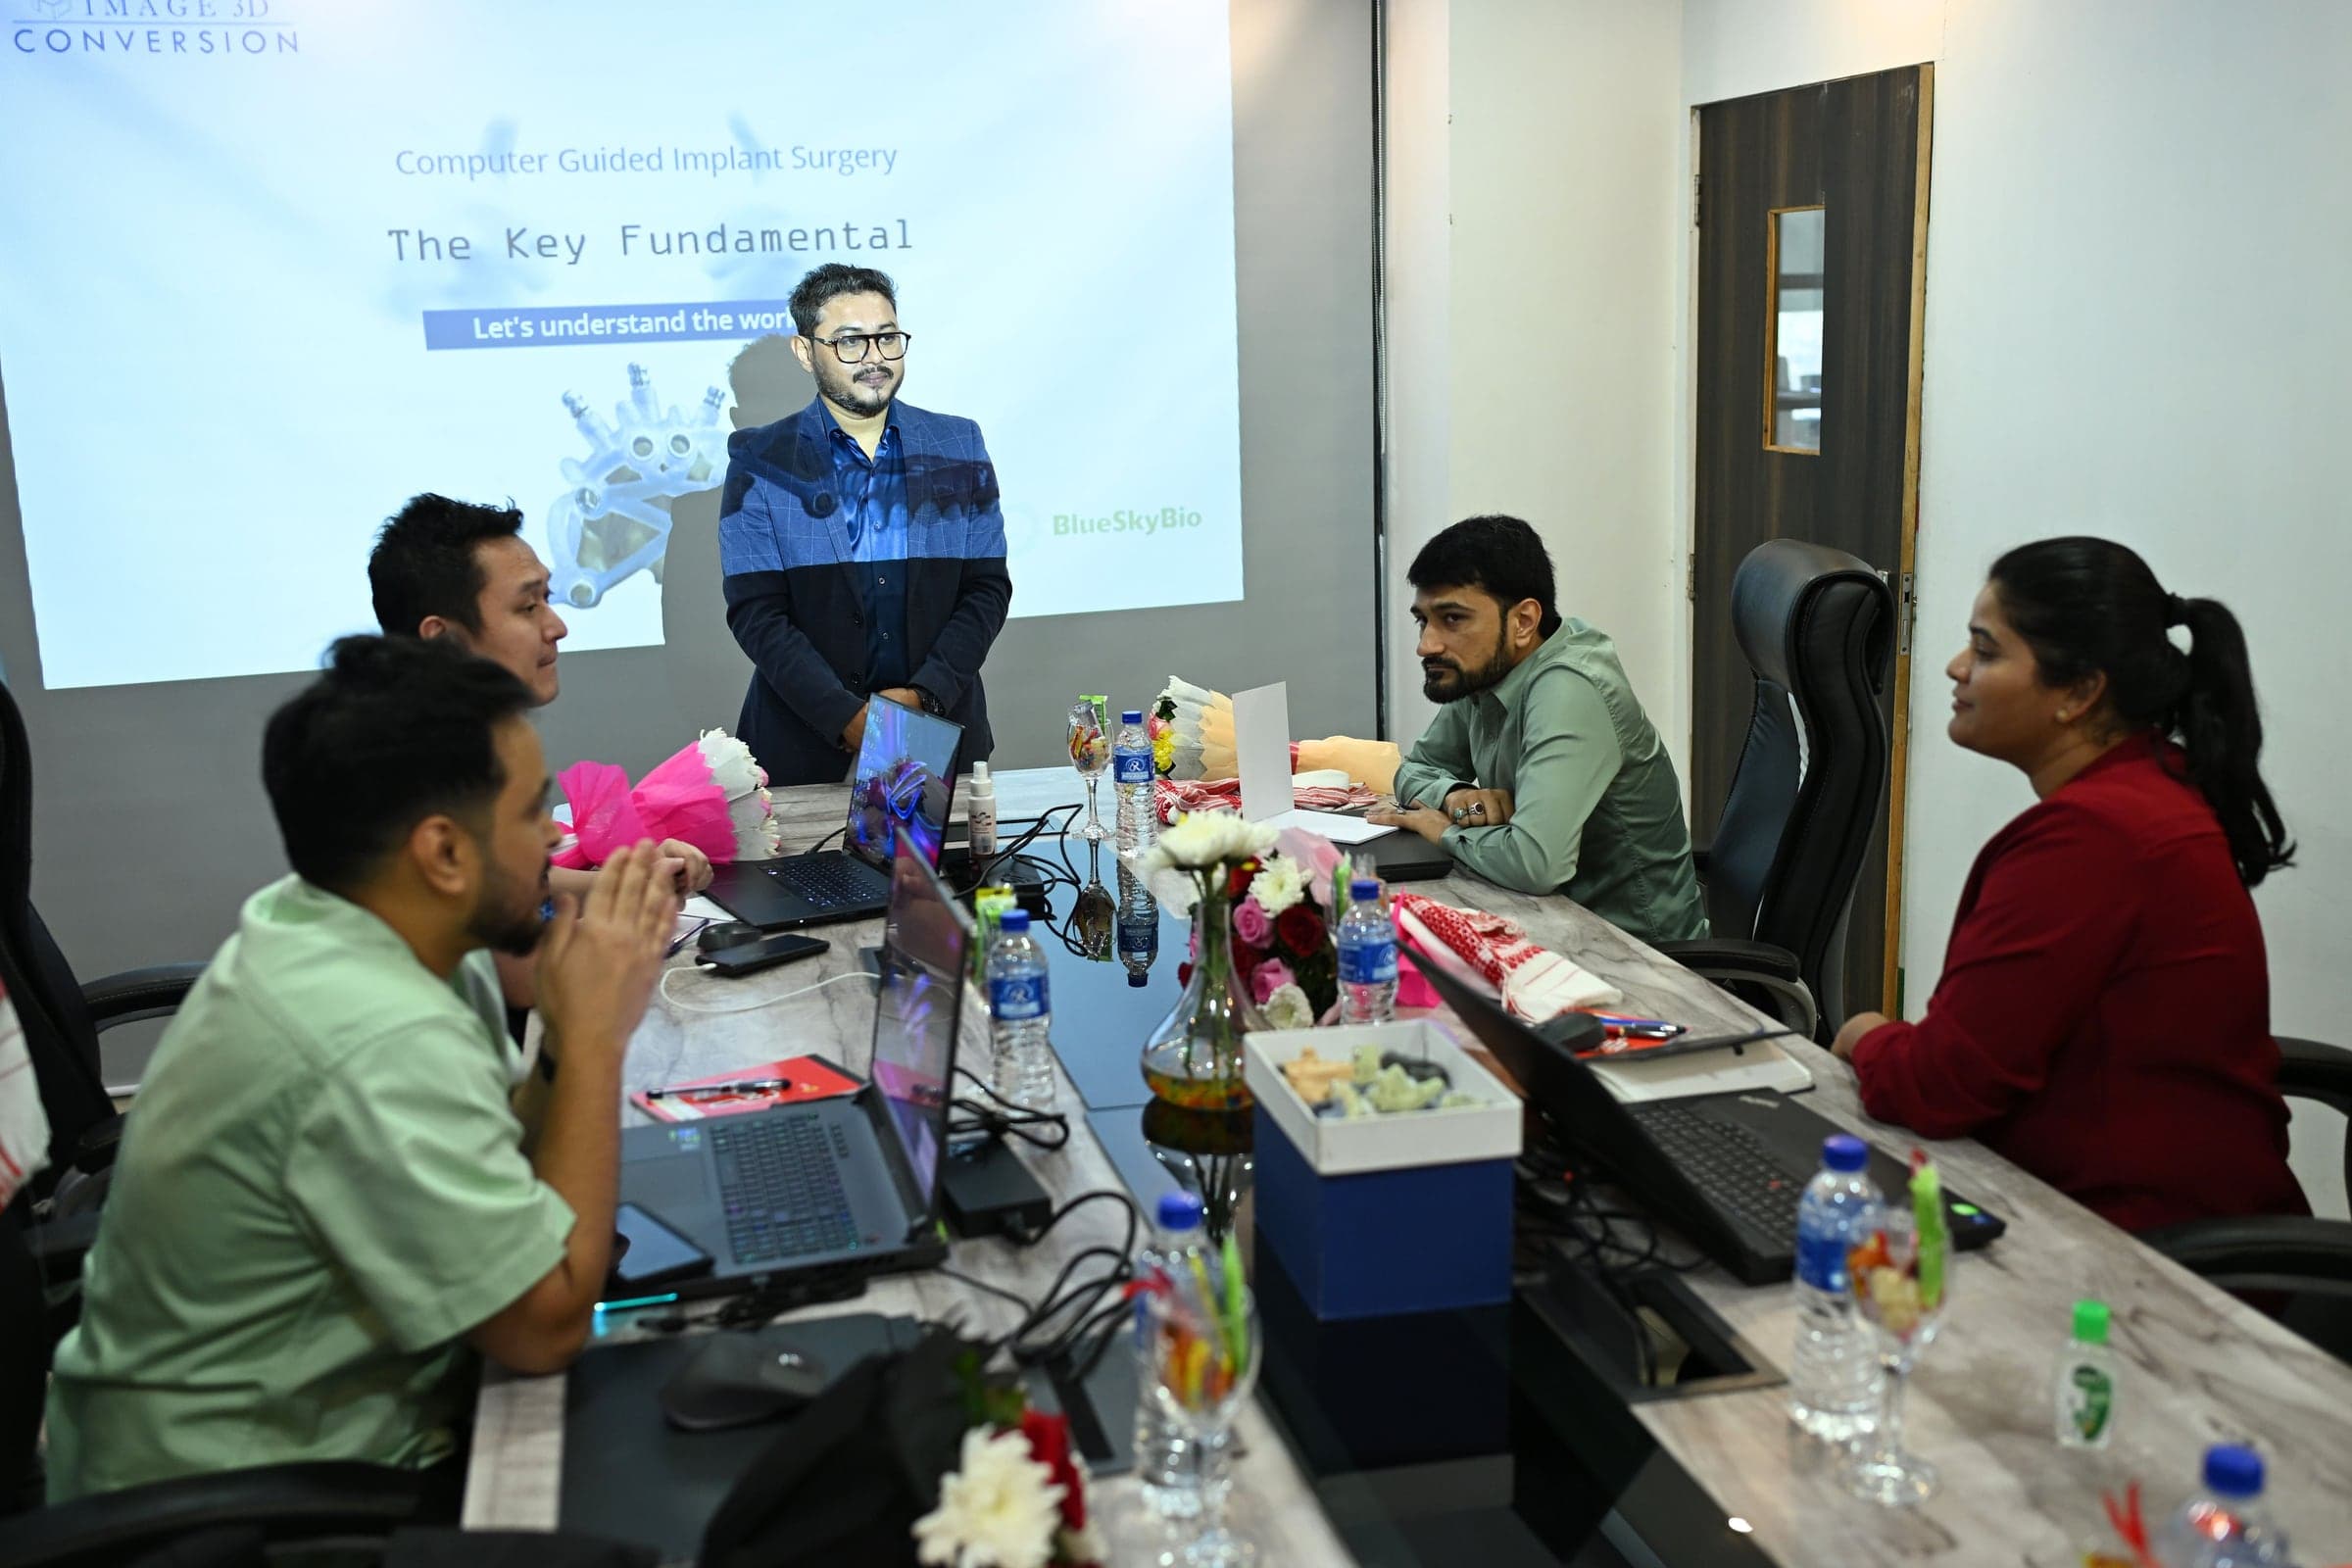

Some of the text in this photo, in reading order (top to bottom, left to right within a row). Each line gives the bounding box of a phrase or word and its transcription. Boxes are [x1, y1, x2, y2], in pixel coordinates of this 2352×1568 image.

[85, 0, 217, 18] IMAGE
[14, 28, 299, 53] CONVERSION
[396, 145, 898, 181] Computer Guided Implant Surgery
[388, 218, 913, 266] The Key Fundamental
[472, 316, 535, 339] Let's
[540, 310, 686, 337] understand
[690, 308, 735, 332] the
[1053, 506, 1203, 536] BlueSkyBio
